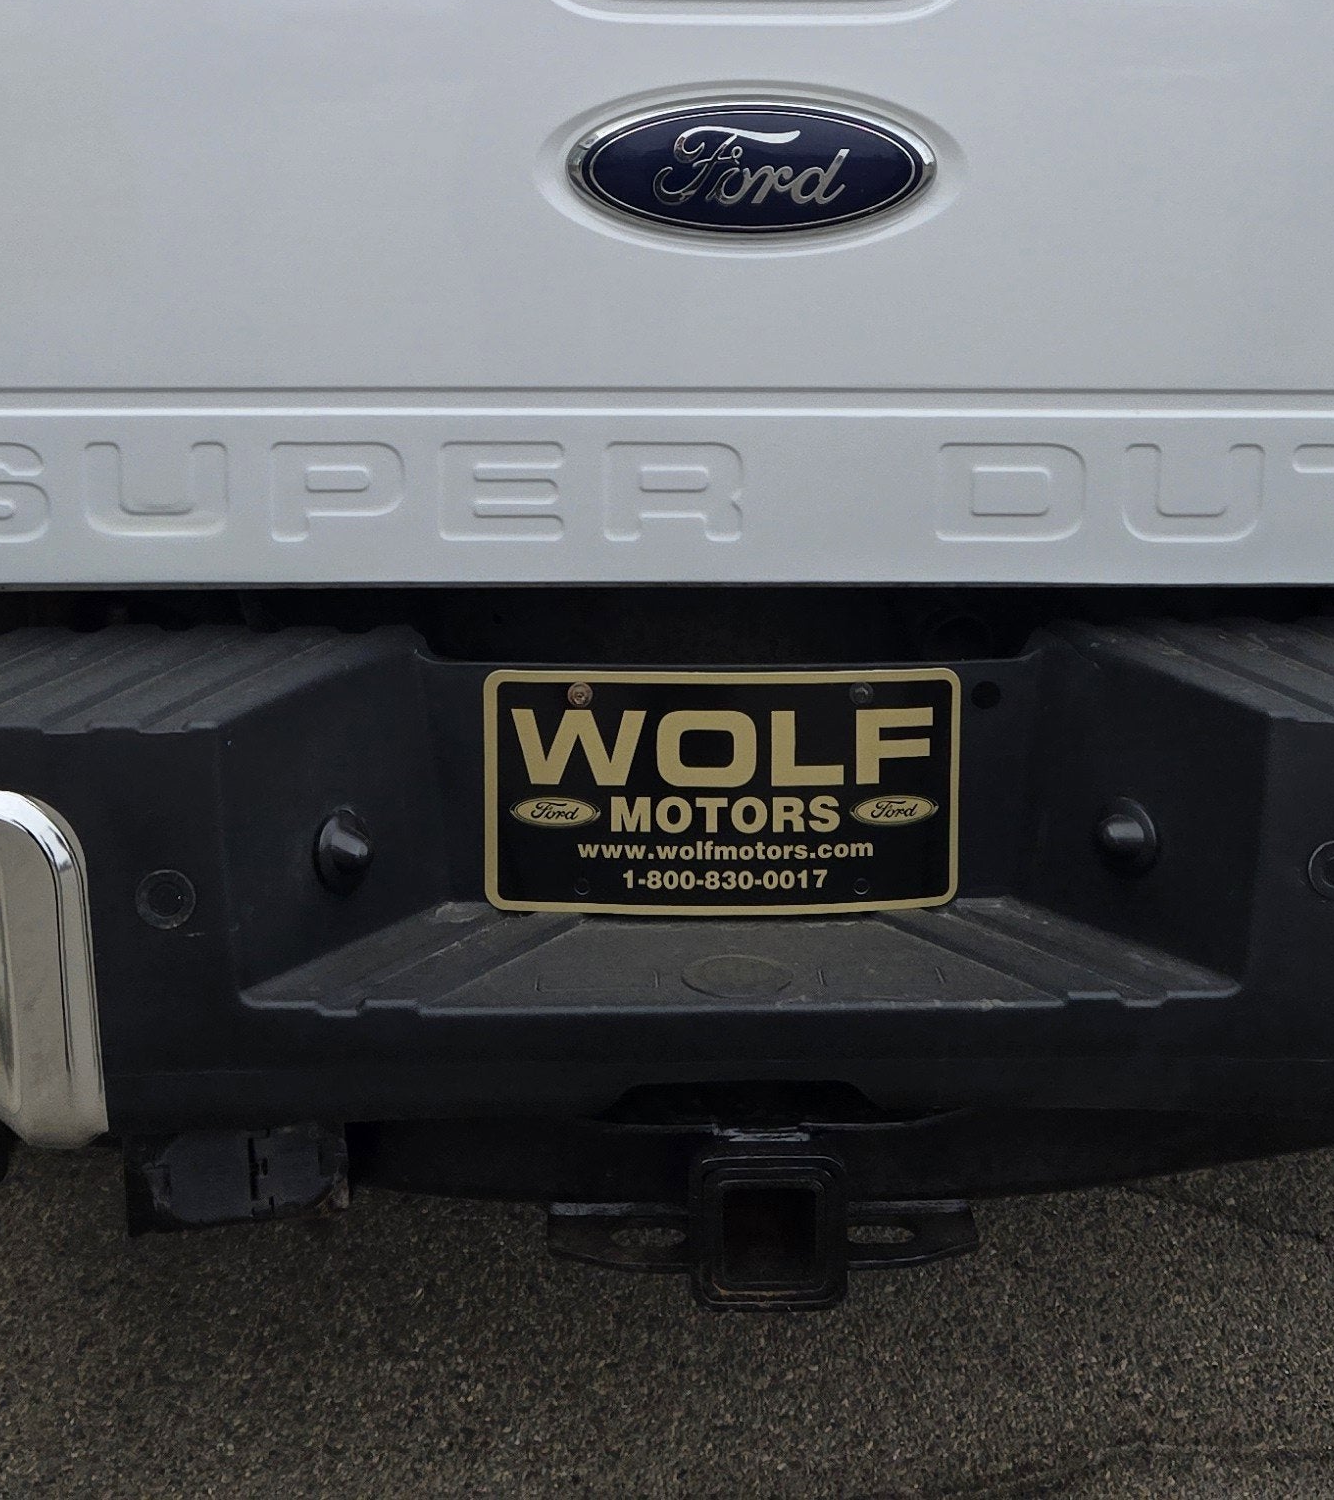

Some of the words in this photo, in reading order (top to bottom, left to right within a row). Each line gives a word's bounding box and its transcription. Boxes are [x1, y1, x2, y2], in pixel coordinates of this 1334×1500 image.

[653, 124, 851, 206] Ford
[510, 707, 934, 788] WOLF
[530, 801, 580, 820] Ford
[610, 795, 841, 834] MOTORS
[870, 800, 918, 819] Ford
[577, 839, 874, 861] www.wolfmotors.com
[622, 869, 828, 891] 1-800-830-0017
